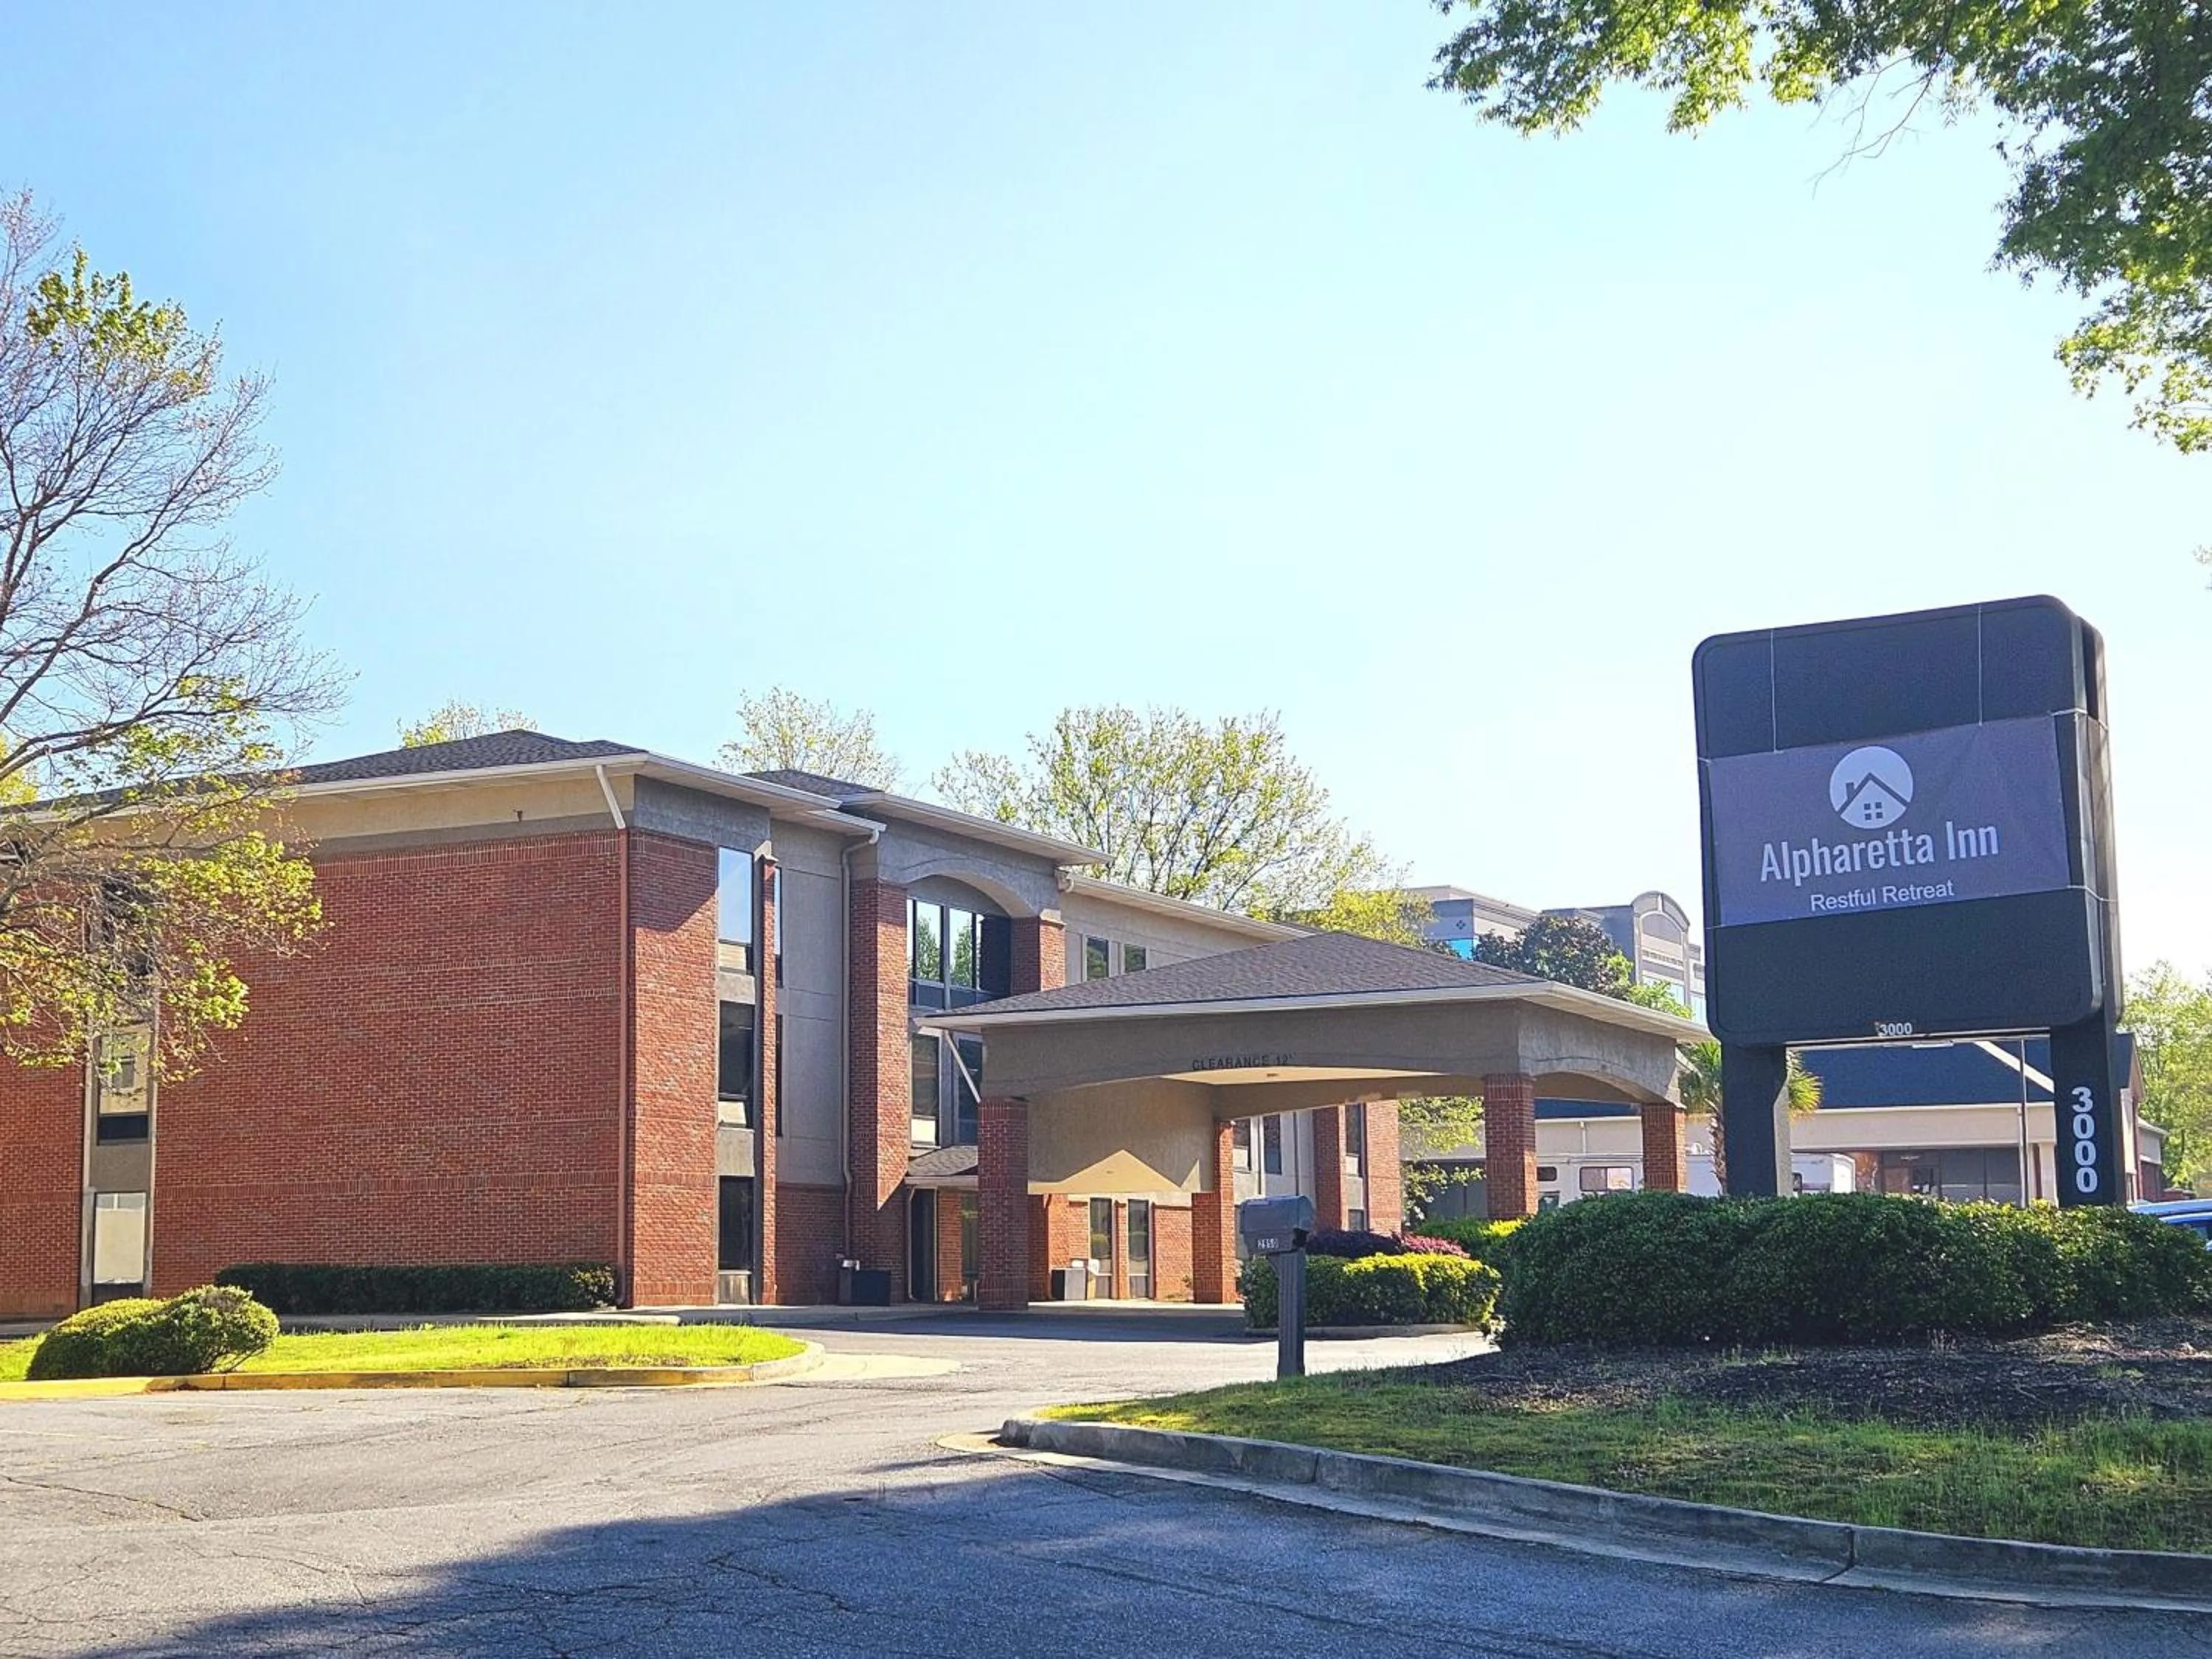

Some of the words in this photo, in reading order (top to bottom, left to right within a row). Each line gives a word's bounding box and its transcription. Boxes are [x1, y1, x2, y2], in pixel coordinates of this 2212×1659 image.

[1760, 828, 1935, 886] Alpharetta
[1947, 821, 1999, 860] Inn
[1810, 888, 1877, 911] Restful
[1883, 880, 1955, 903] Retreat
[1878, 1022, 1913, 1036] 3000
[1192, 1055, 1269, 1071] CLEARANCE
[2071, 1086, 2098, 1193] 3000
